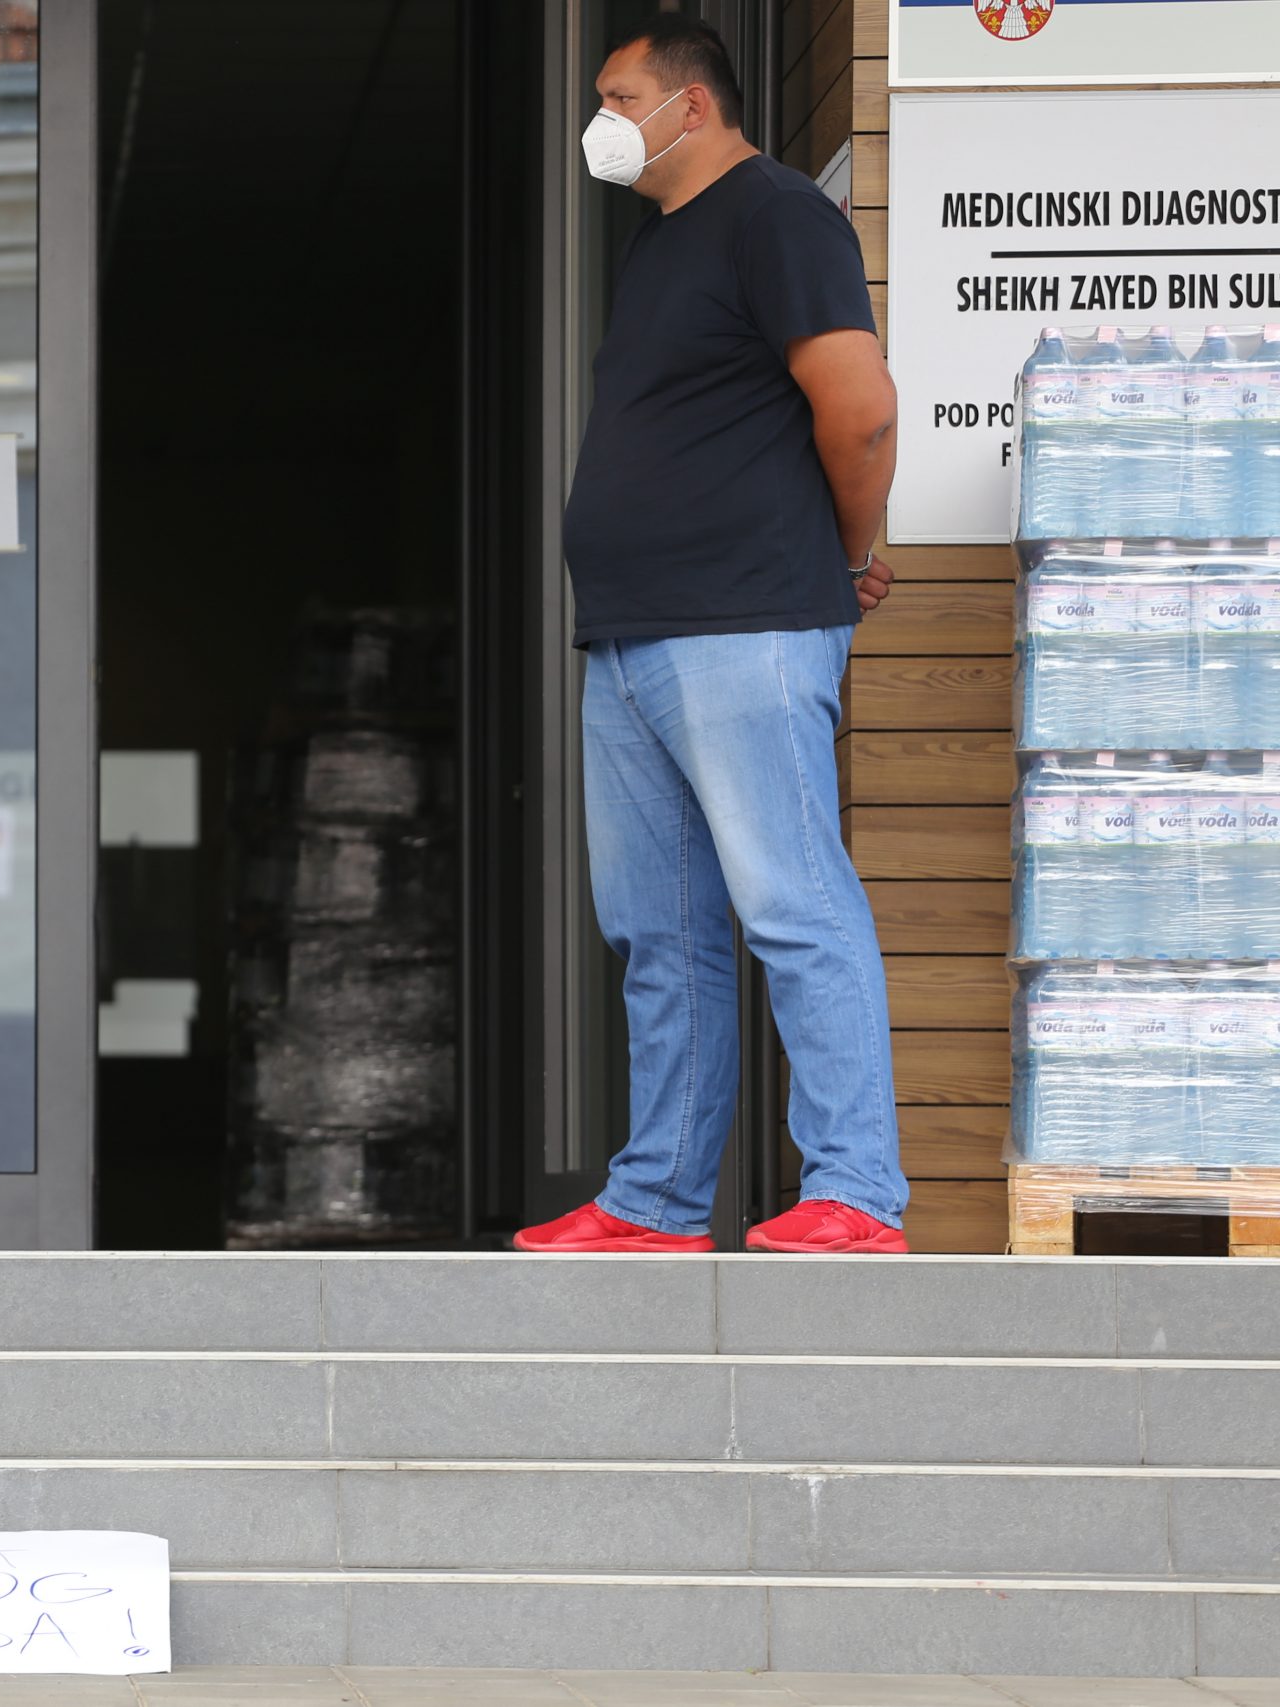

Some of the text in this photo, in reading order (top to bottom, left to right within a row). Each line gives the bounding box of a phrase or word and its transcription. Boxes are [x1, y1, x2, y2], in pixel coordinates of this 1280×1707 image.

[941, 188, 1280, 228] MEDICINSKI DIJAGNOST
[956, 276, 1060, 312] SHEIKH
[1069, 274, 1158, 310] ZAYED
[1168, 273, 1219, 309] BIN
[934, 402, 979, 428] POD
[1198, 812, 1237, 828] voda
